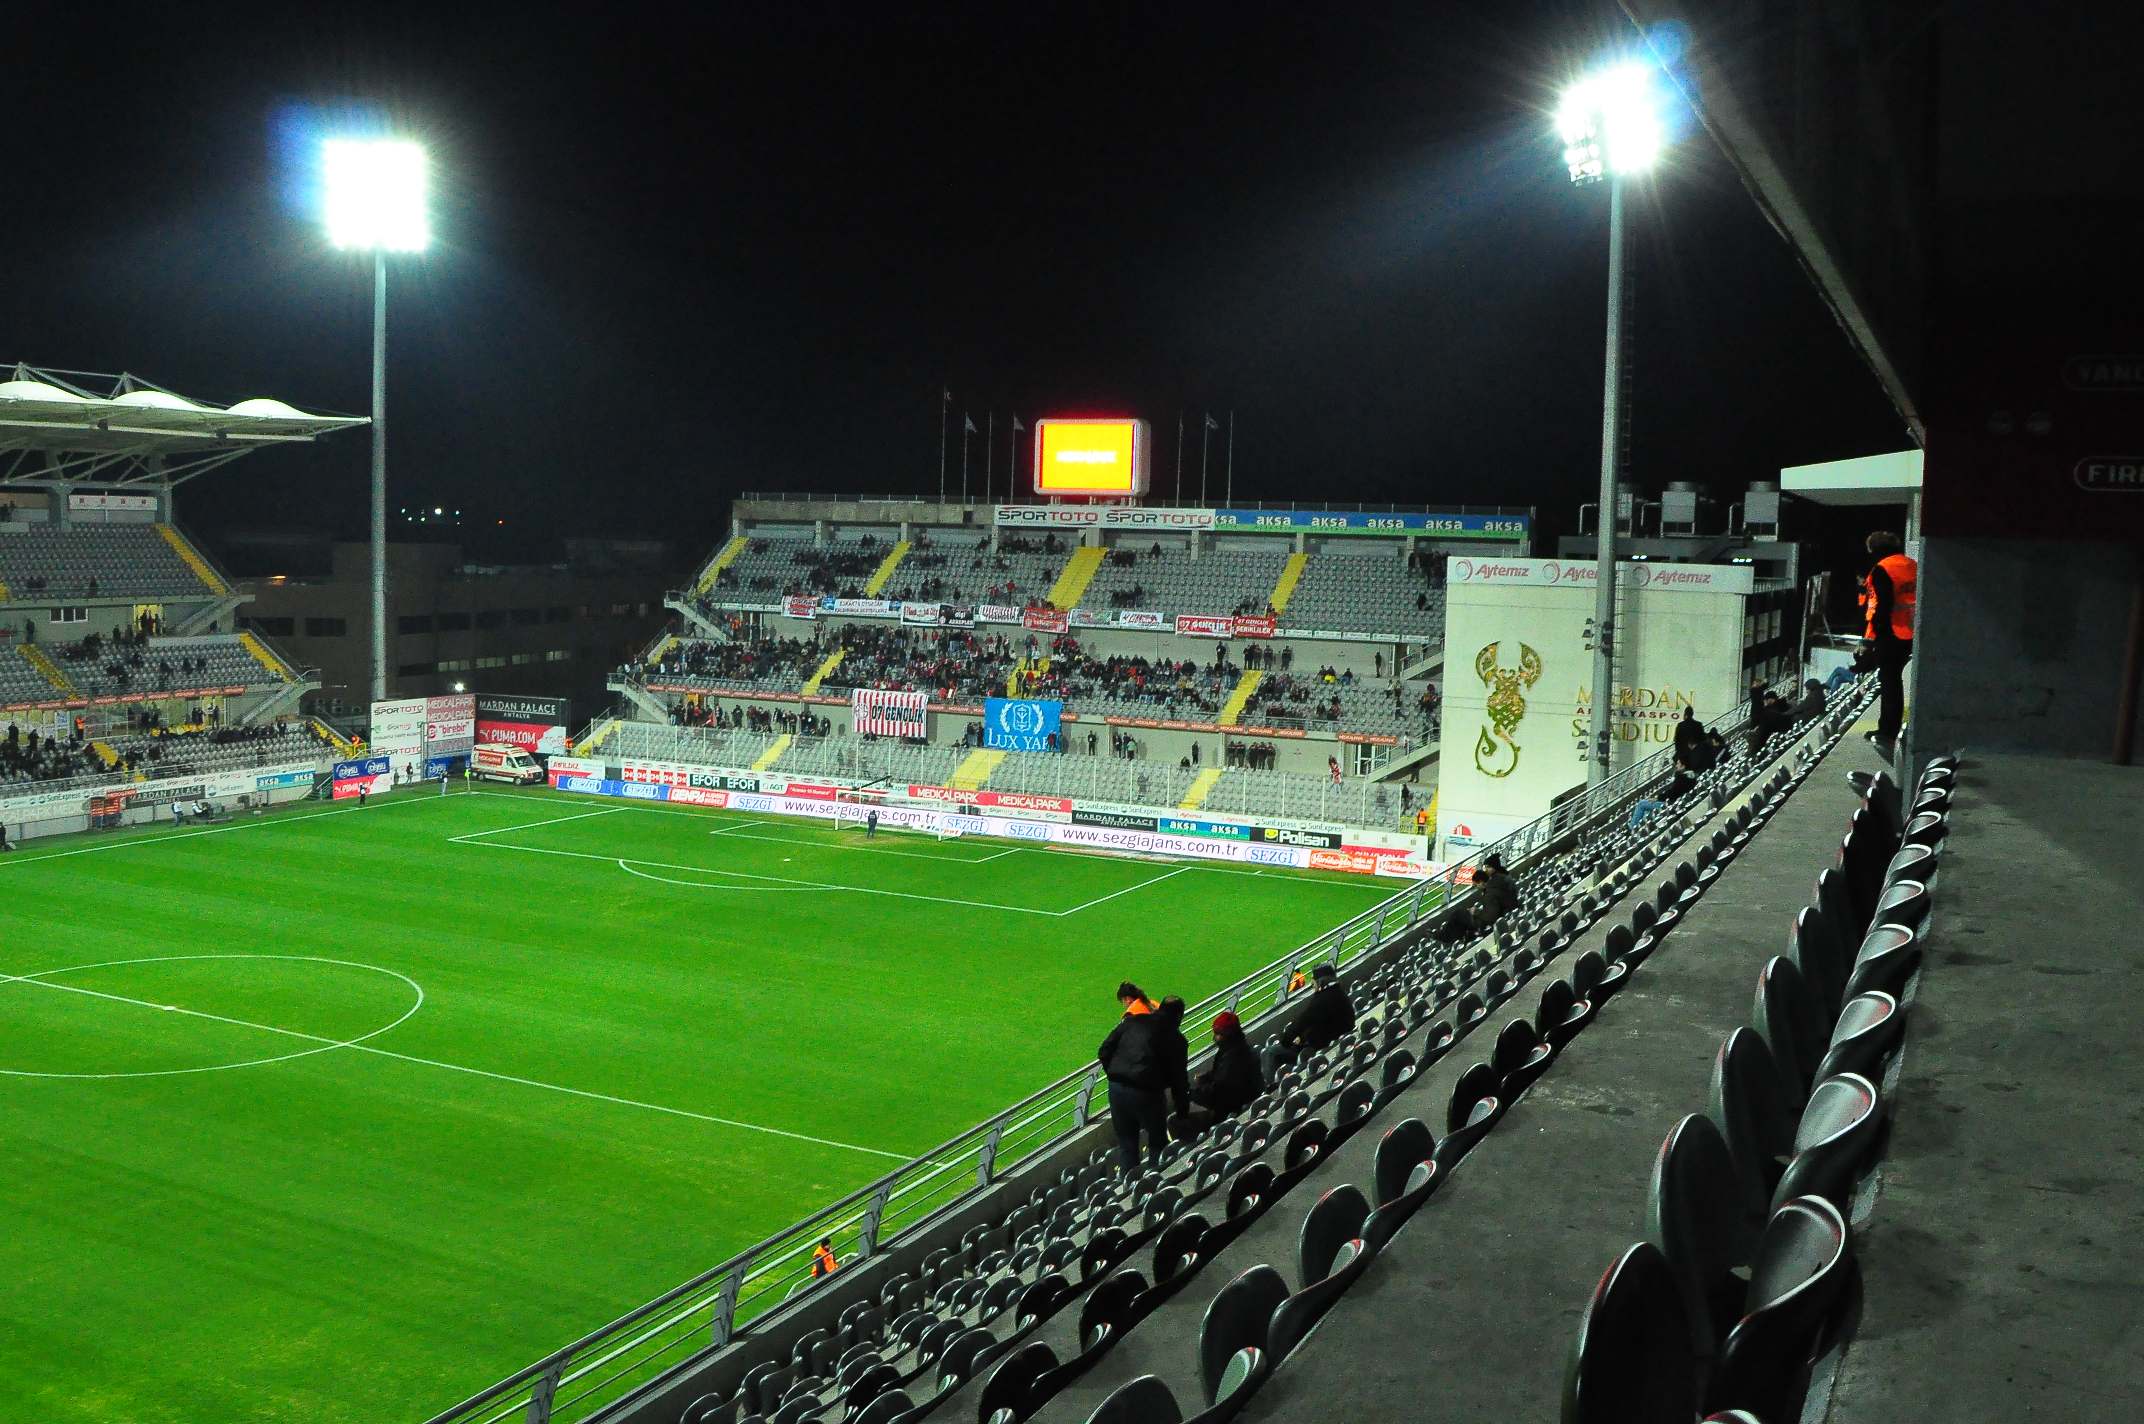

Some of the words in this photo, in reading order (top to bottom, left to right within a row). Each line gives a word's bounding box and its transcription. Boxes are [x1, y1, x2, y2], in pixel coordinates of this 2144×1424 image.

[1213, 514, 1237, 525] ksa
[1576, 685, 1696, 710] MRDAN
[692, 774, 719, 787] EFOR
[726, 777, 755, 790] EFOR
[997, 795, 1062, 810] MEDICALPARK
[1279, 830, 1329, 848] Polisan
